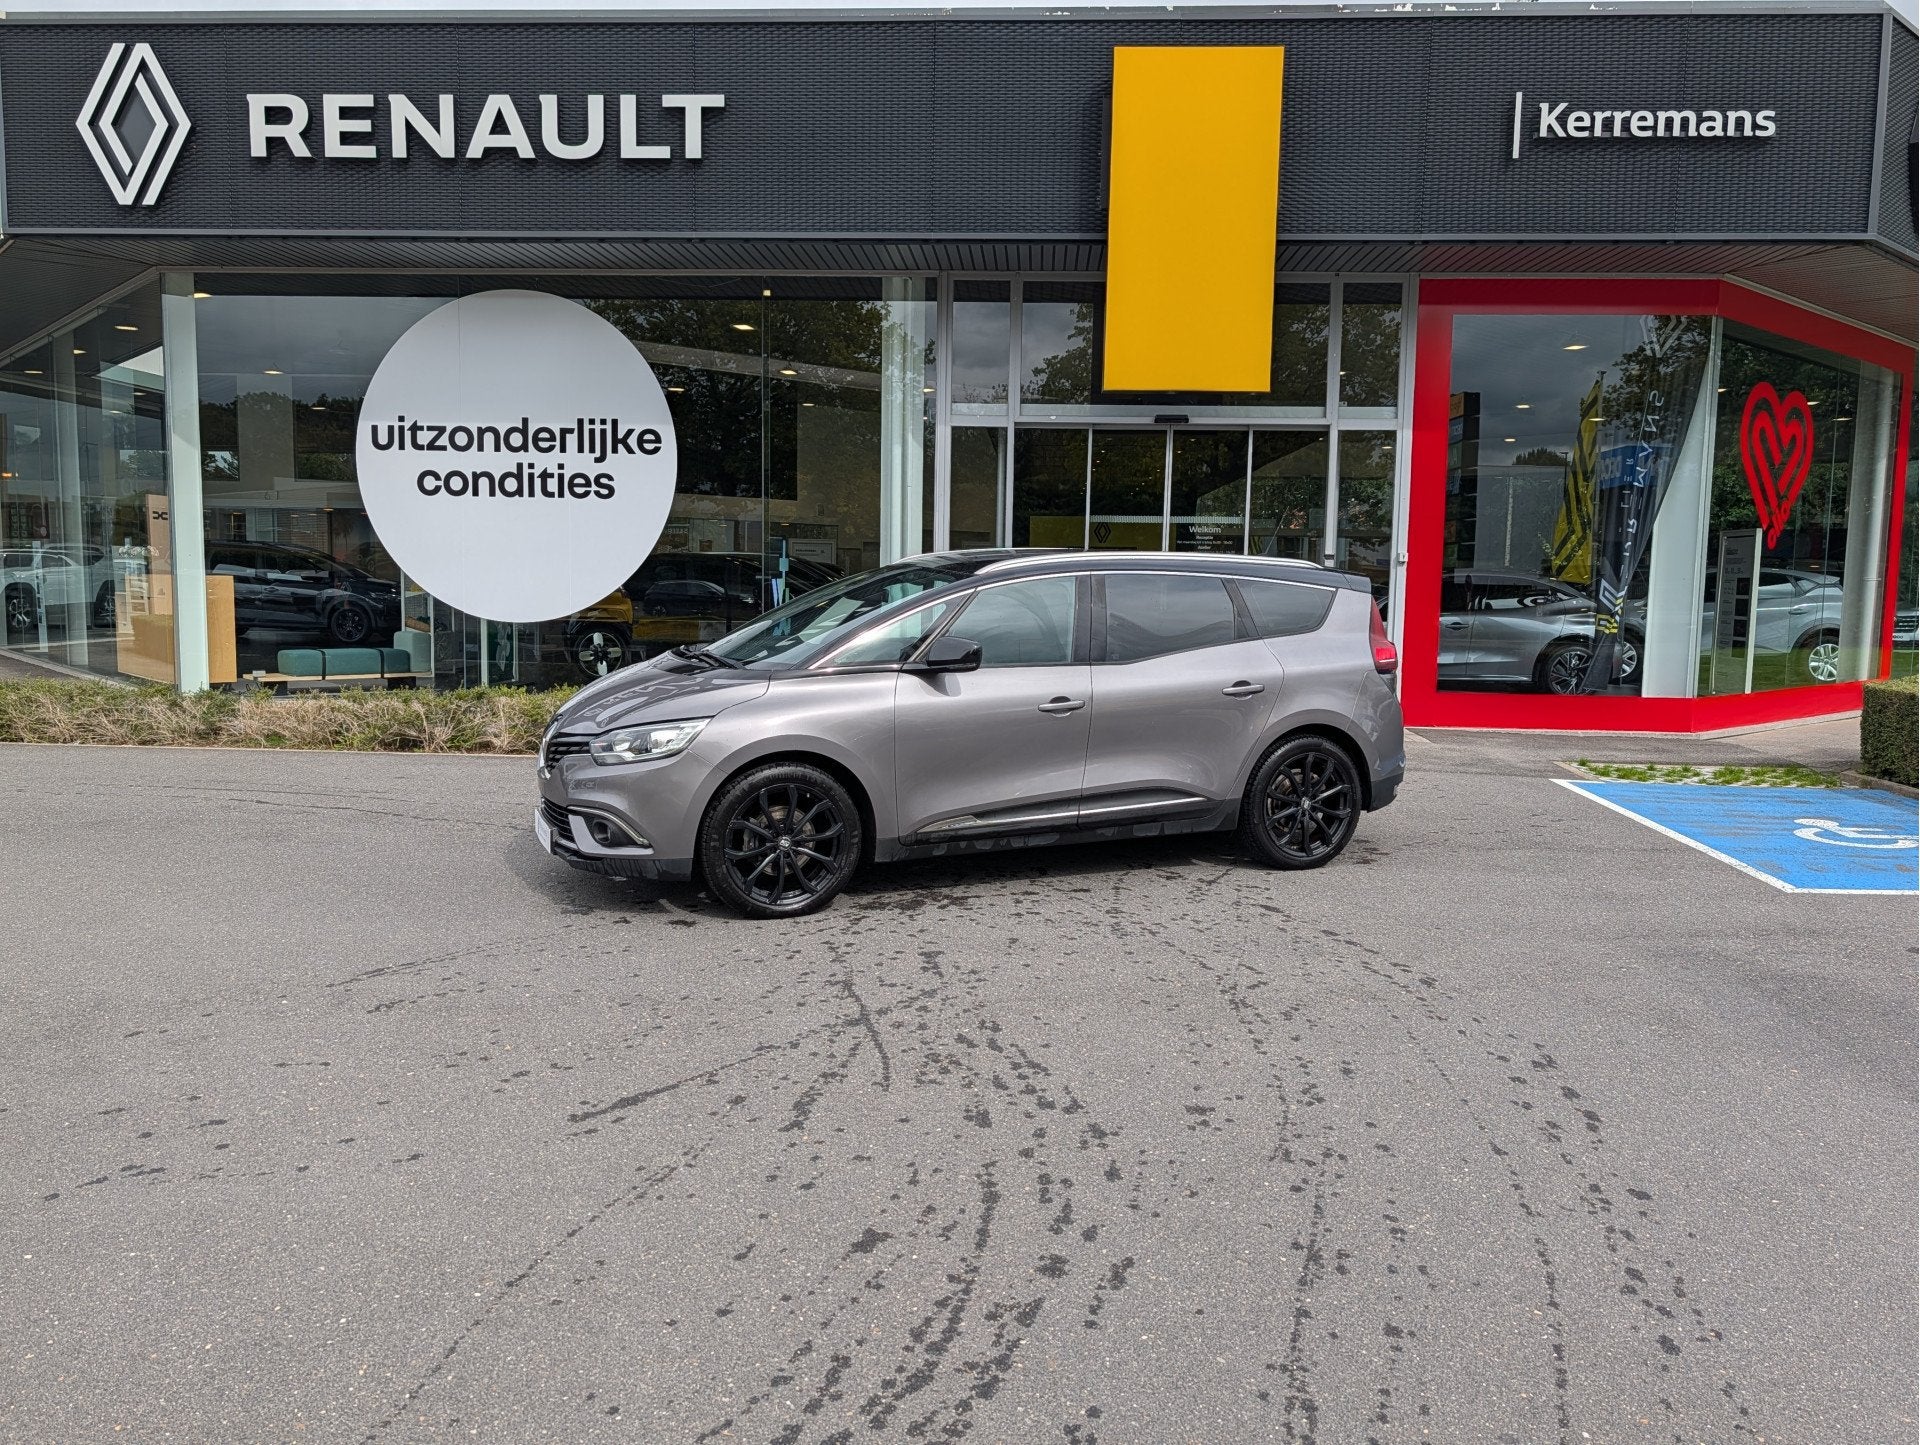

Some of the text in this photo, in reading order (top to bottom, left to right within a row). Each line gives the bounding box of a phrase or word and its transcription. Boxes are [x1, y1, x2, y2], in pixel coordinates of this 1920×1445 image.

[247, 93, 726, 160] RENAULT
[1539, 102, 1777, 138] Kerremans
[371, 415, 662, 464] uitzonderlijke
[416, 463, 616, 500] condities
[1189, 525, 1222, 534] Welkom
